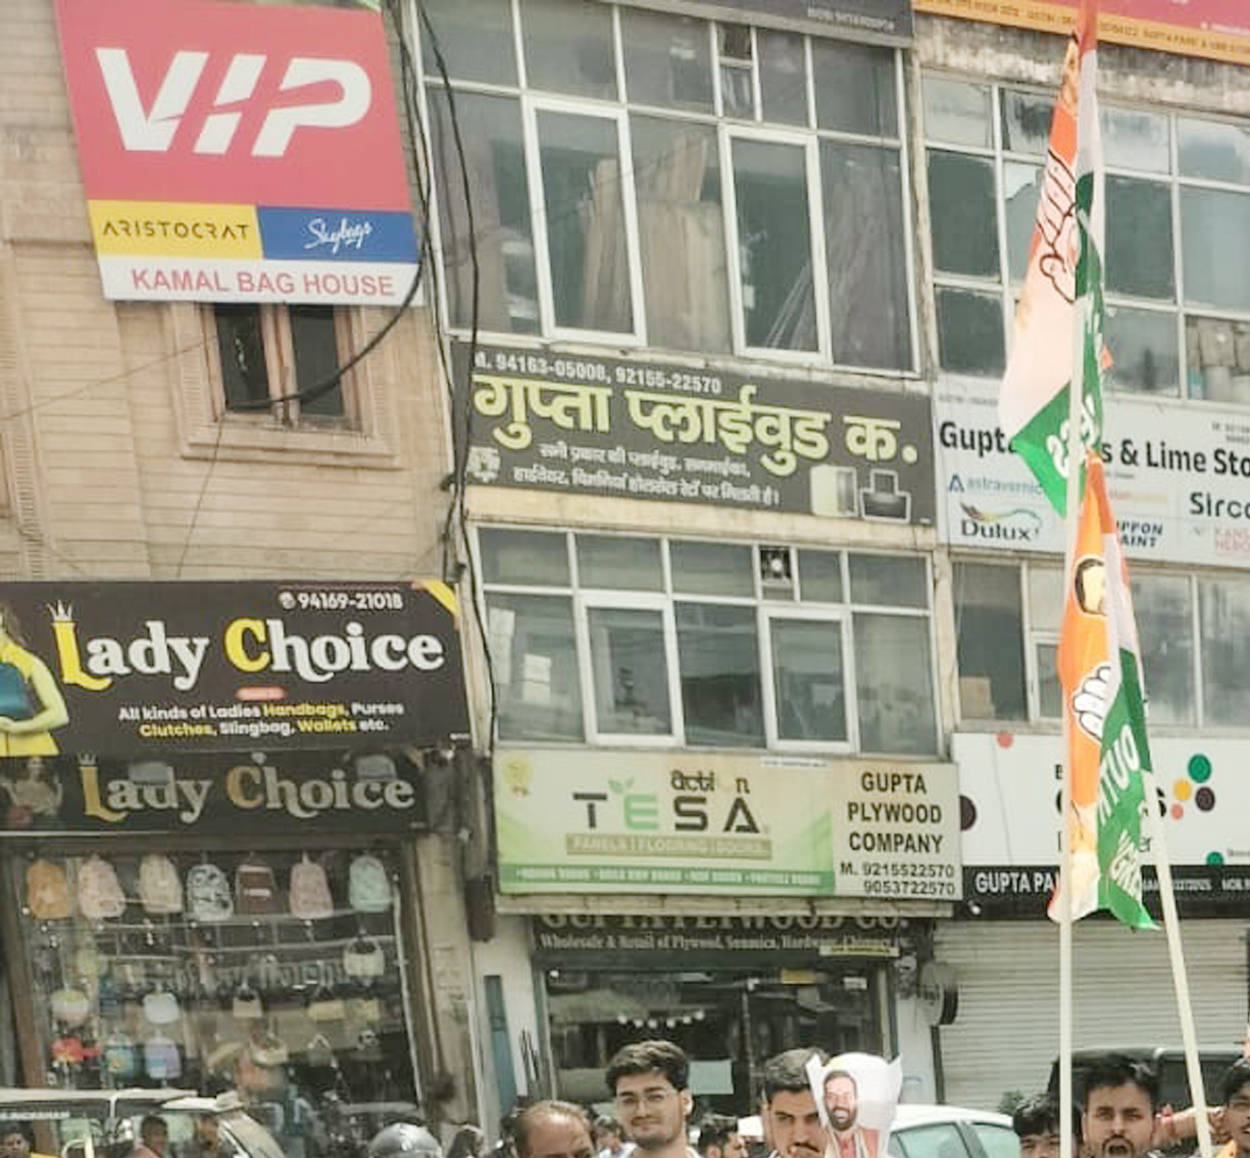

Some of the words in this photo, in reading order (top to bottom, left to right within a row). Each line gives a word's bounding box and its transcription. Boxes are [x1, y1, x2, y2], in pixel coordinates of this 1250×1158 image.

[95, 48, 371, 157] VIP
[102, 219, 250, 240] ARISTOCRAT
[133, 268, 229, 293] KAMAL
[238, 271, 294, 295] BAG
[304, 273, 395, 296] HOUSE
[472, 373, 612, 450] गुप्ता
[625, 385, 831, 476] प्लाईवुड
[842, 415, 917, 464] क.
[1121, 439, 1139, 466] &
[1146, 441, 1207, 474] Lime
[961, 519, 1031, 542] Dulux
[1116, 520, 1163, 537] IPPON
[1121, 534, 1157, 548] AINT
[53, 619, 209, 691] Lady
[225, 618, 445, 682] Choice
[118, 706, 140, 721] All
[142, 704, 187, 720] kinds
[190, 703, 207, 718] of
[209, 704, 261, 718] Ladies
[299, 719, 356, 734] Wallets
[359, 719, 389, 732] etc.
[670, 769, 751, 795] actin
[861, 771, 927, 794] GUPTA
[80, 766, 213, 823] Lady
[226, 765, 415, 819] Choice
[573, 792, 760, 834] TESA
[847, 801, 942, 824] PLYWOOD
[849, 831, 943, 854] COMPANY
[840, 862, 858, 876] M.
[862, 862, 955, 878] 9215522570
[975, 872, 1031, 893] GUPTA
